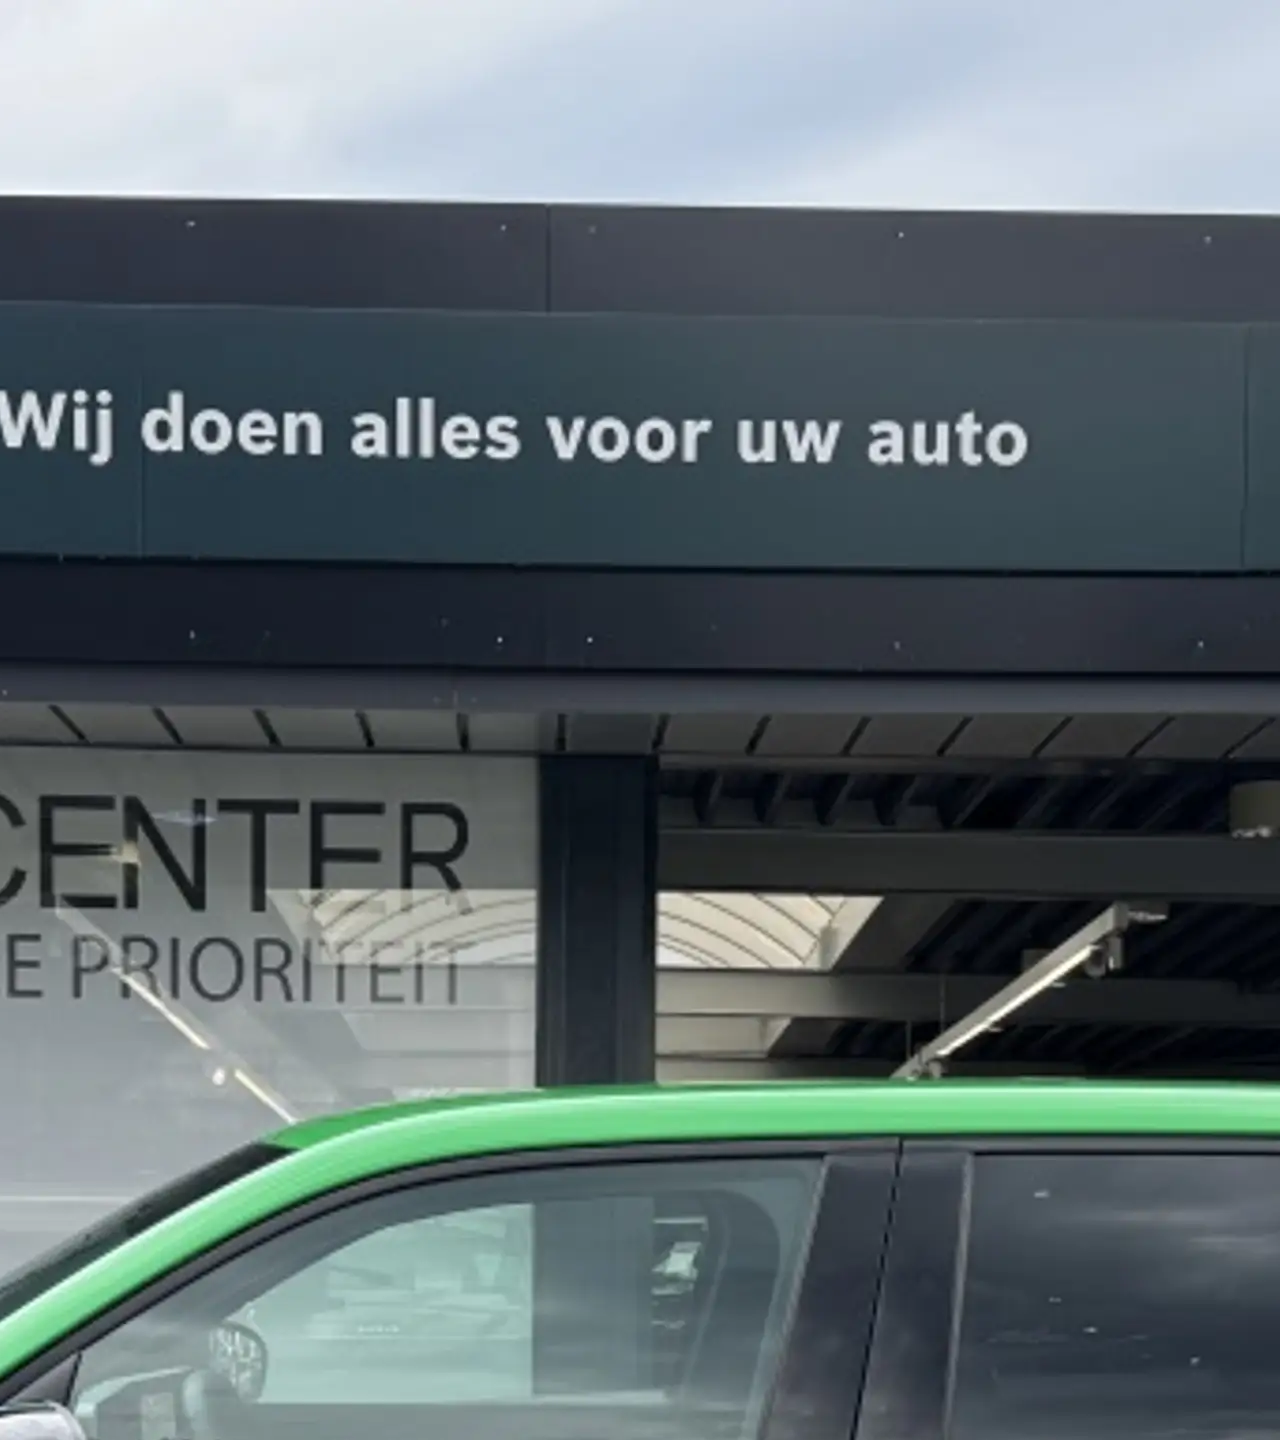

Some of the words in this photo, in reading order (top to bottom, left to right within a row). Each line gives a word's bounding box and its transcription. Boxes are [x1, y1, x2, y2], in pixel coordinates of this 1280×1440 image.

[141, 391, 323, 457] doen
[350, 397, 522, 460] alles
[546, 414, 713, 463] voor
[737, 418, 842, 464] uw
[867, 410, 1029, 466] auto
[71, 934, 476, 1005] PRIORITEIT
